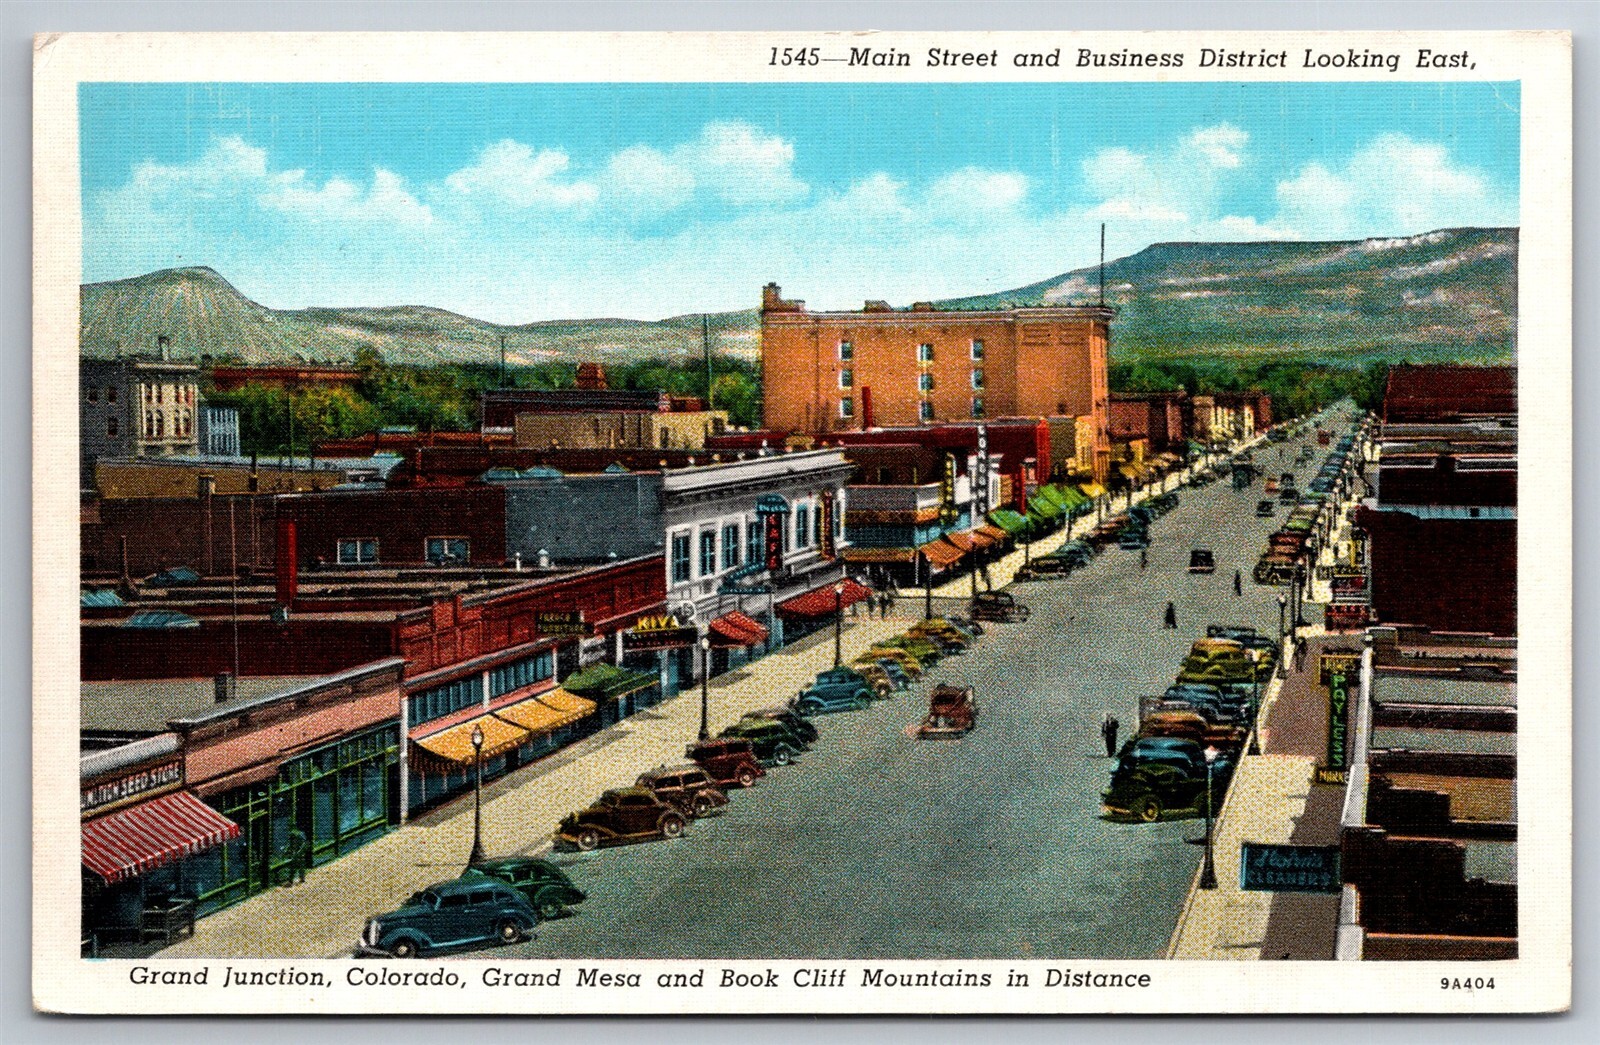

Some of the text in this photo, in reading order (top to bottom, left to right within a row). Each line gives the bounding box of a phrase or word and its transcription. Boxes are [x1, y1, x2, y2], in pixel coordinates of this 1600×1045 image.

[927, 48, 998, 67] Street
[1013, 48, 1061, 67] and
[1076, 48, 1184, 67] Business
[1199, 48, 1287, 68] District
[1303, 49, 1401, 72] Looking
[1415, 49, 1476, 70] East,
[767, 512, 781, 569] CAFE
[636, 614, 681, 632] KIVA
[1332, 673, 1347, 768] PAYLESS
[120, 772, 148, 796] SEED
[151, 761, 180, 787] STORE
[129, 966, 1151, 989] Grand Junction, Colorado, Grand Mesa and Book Cliff Mountains in Distance
[1440, 977, 1495, 990] 9A404
